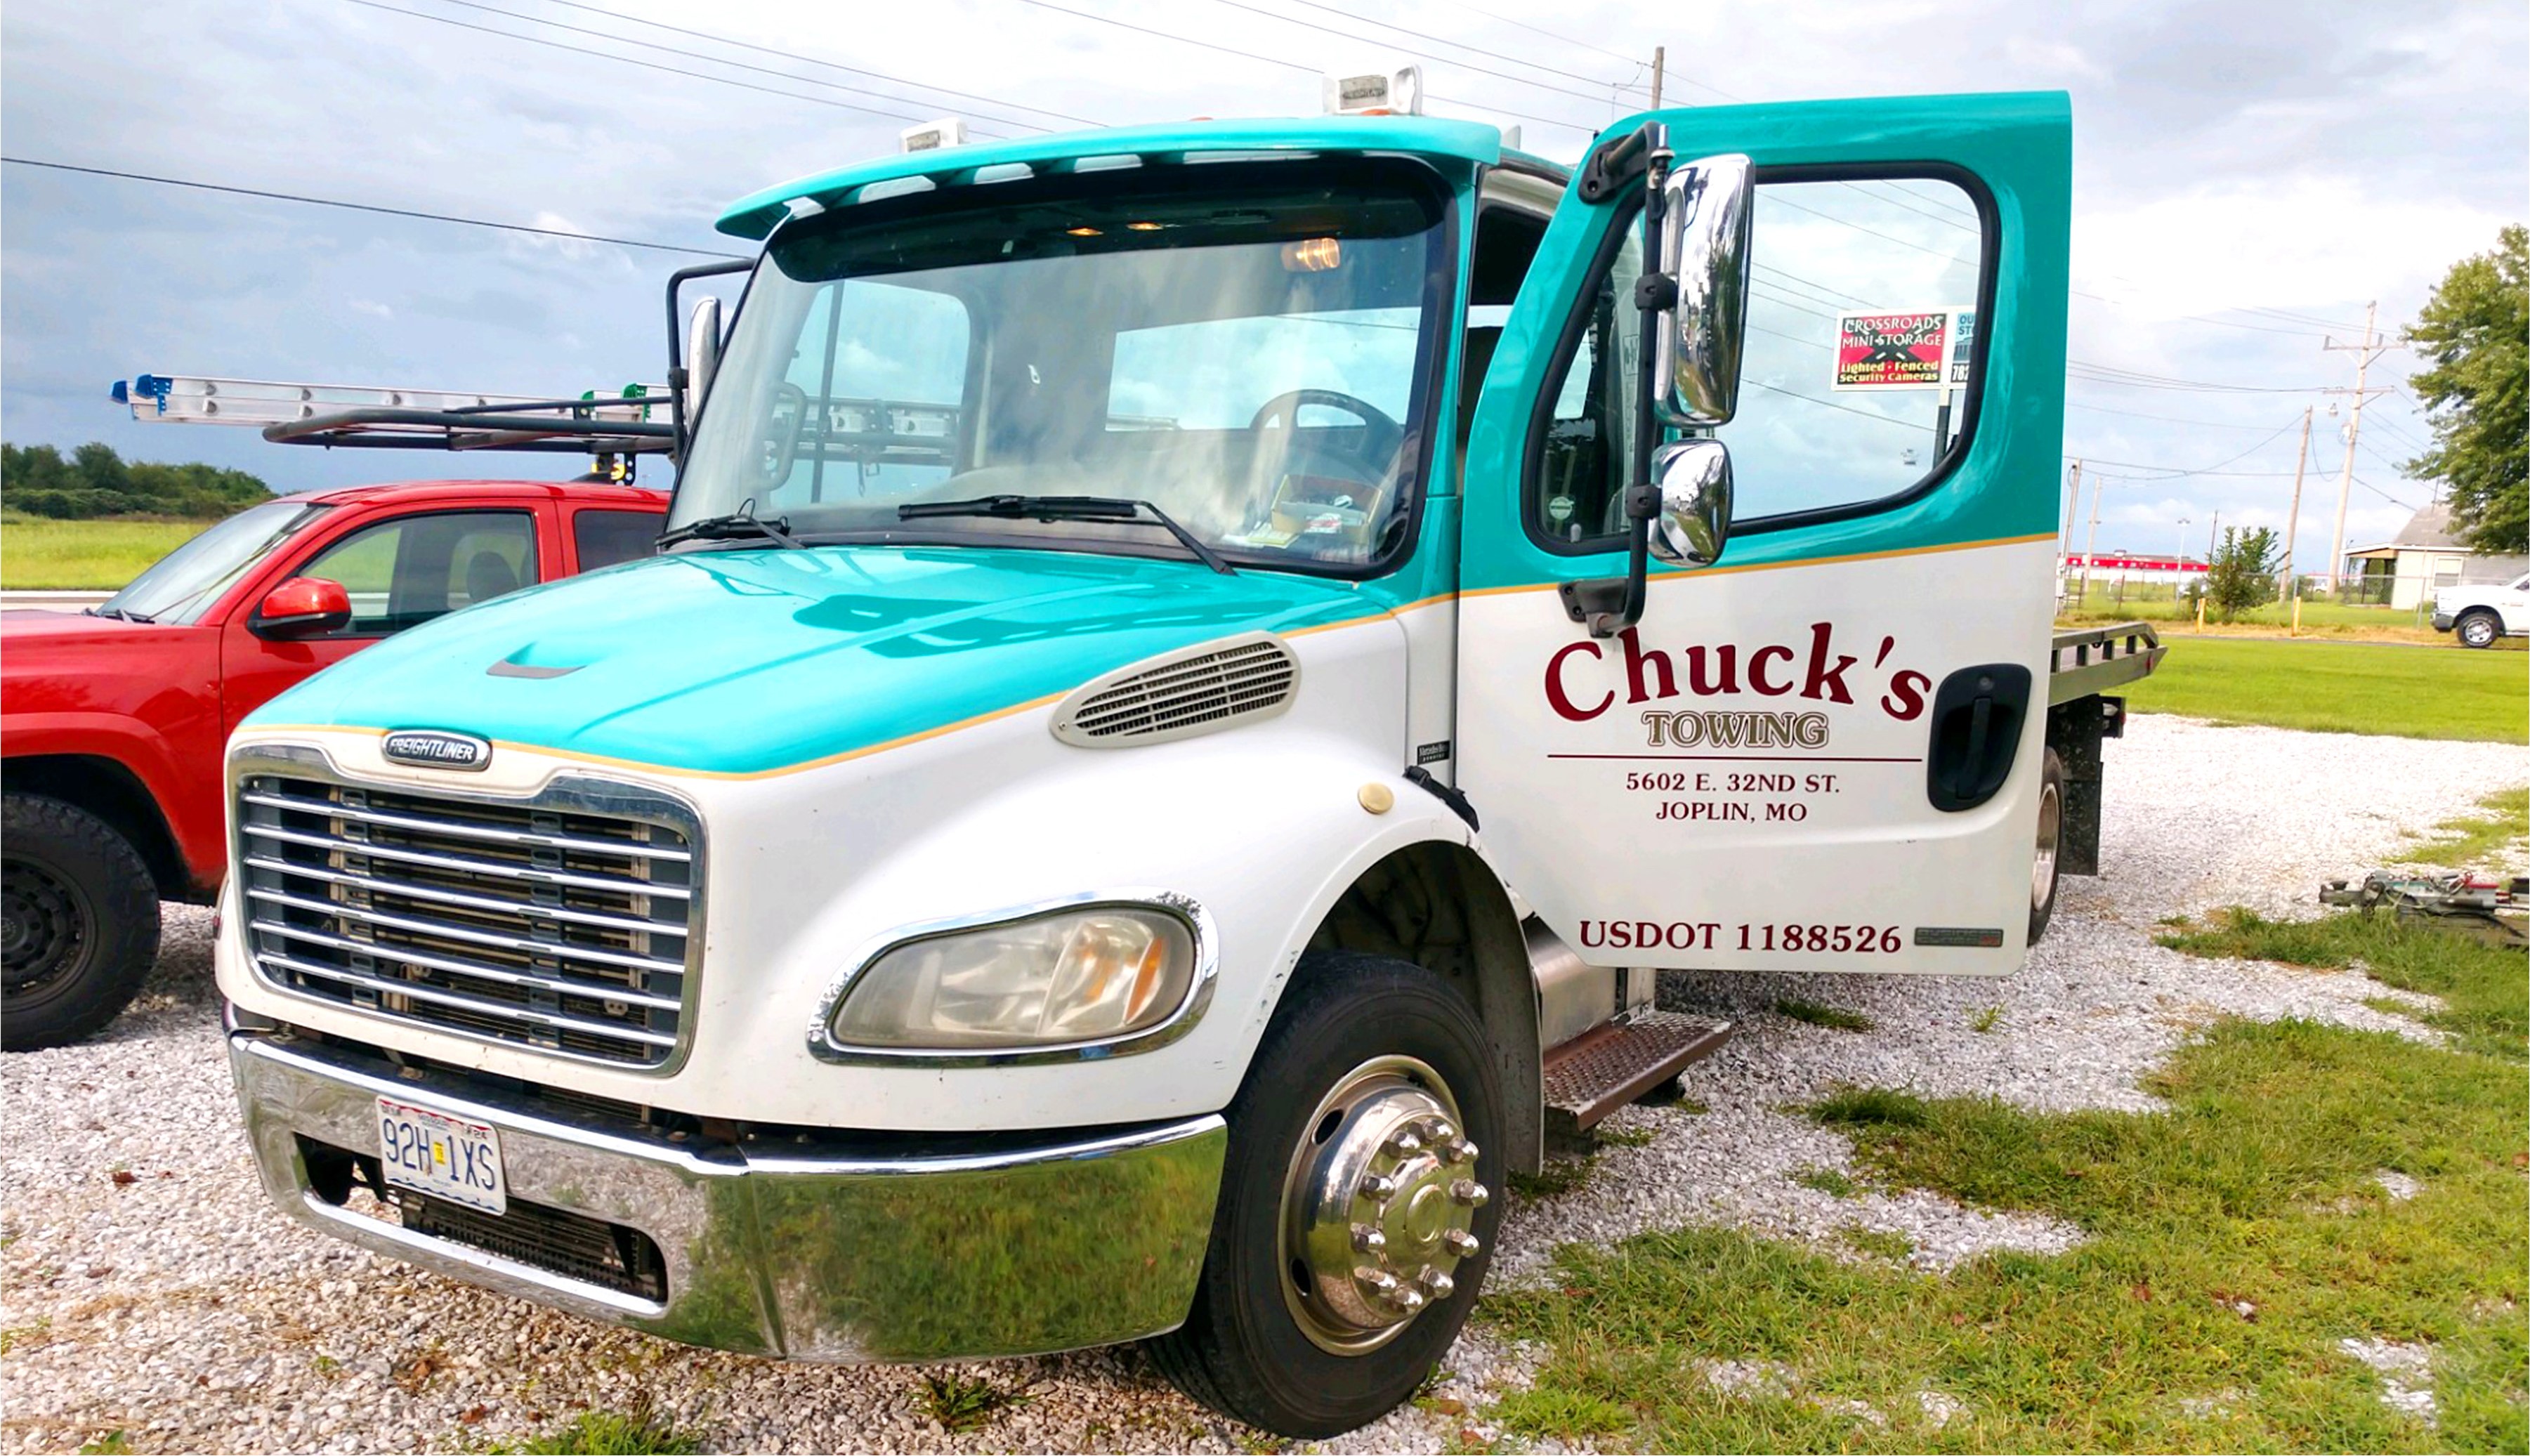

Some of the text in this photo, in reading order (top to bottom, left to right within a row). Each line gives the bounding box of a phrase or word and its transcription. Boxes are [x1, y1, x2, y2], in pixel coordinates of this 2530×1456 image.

[1844, 316, 1943, 332] CROSSROADS
[1839, 372, 1938, 383] Security Cameras
[1840, 360, 1939, 374] Lighted Fenced
[1545, 622, 1932, 721] Chuck's
[1641, 711, 1829, 749] TOWING
[388, 738, 474, 760] FREIGHTLINER
[1626, 773, 1840, 793] 5602 E. 32ND ST.
[1656, 801, 1808, 823] JOPLIN, MO
[1580, 920, 1722, 950] USDOT
[1738, 925, 1902, 954] 1188526
